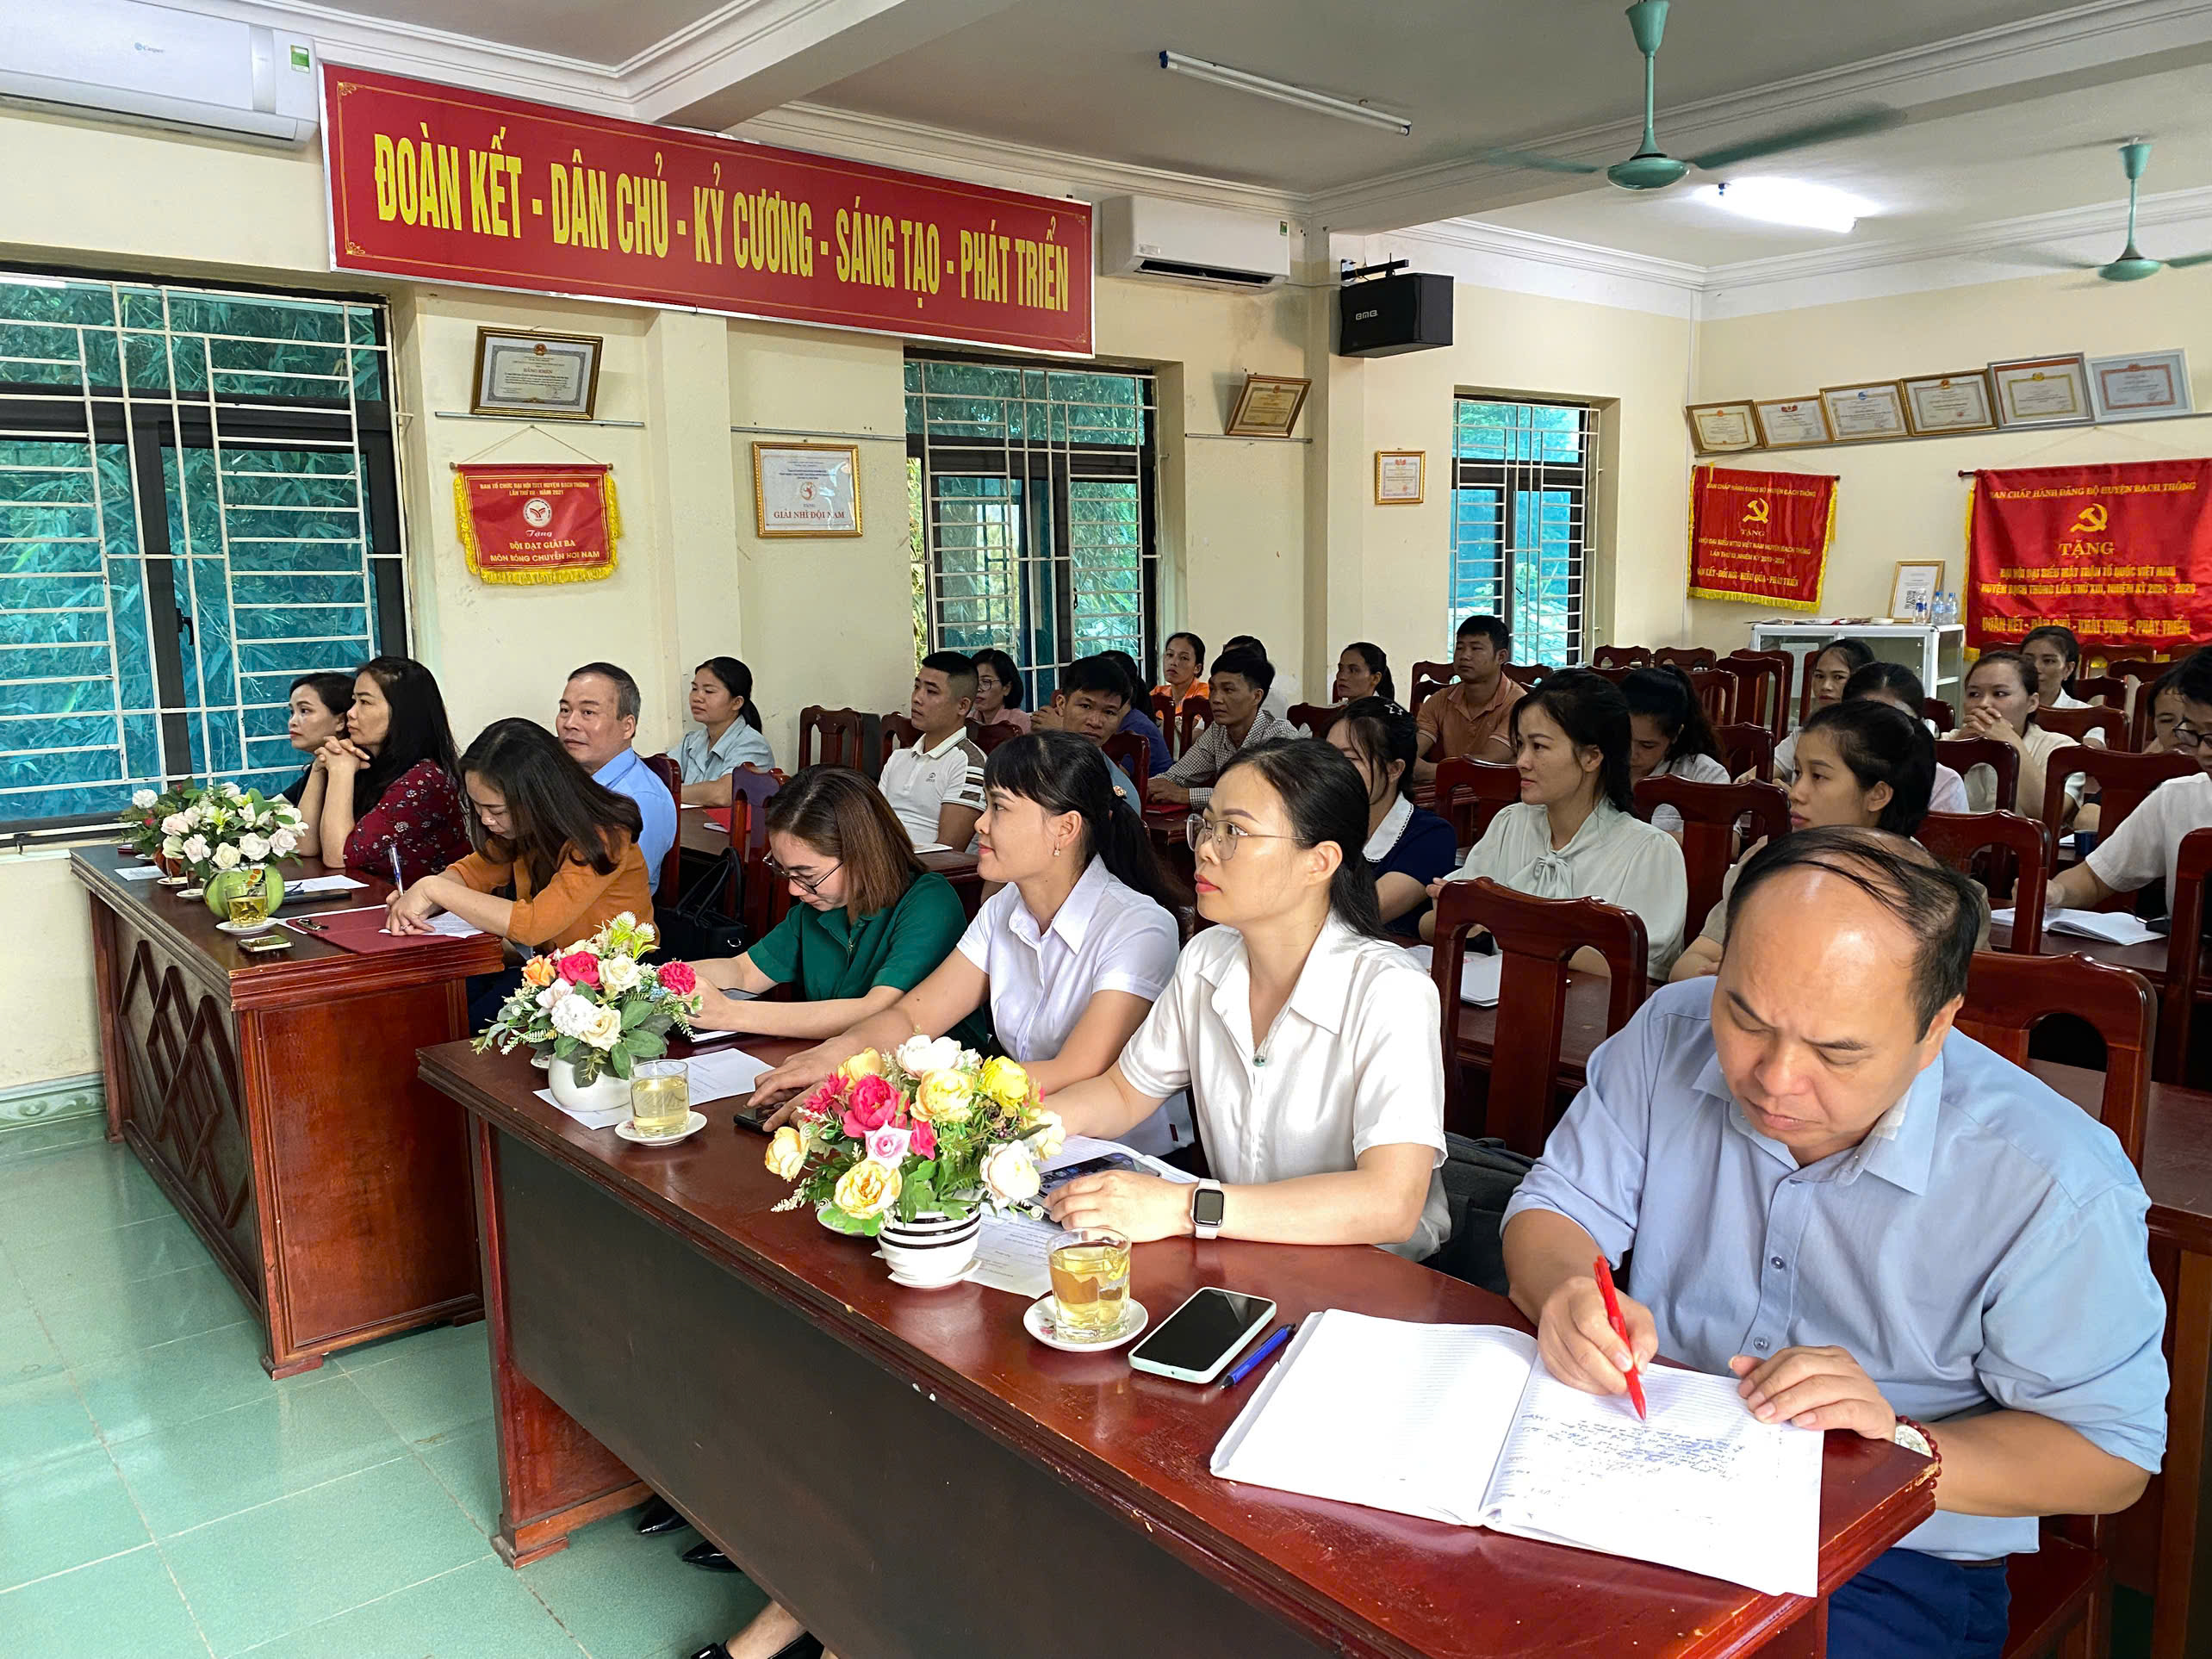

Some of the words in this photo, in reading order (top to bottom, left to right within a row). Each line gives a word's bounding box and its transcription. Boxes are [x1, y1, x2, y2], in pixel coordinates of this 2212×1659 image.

[374, 121, 463, 231] ĐOÀN
[469, 127, 522, 239] KẾT
[550, 148, 609, 251] DÂN
[615, 151, 669, 258] CHỦ
[693, 161, 724, 265] KỶ
[732, 188, 814, 277] CƯƠNG
[836, 196, 896, 289] SÁNG
[900, 219, 940, 308] TẠO
[960, 219, 1010, 304] PHÁT
[1015, 214, 1069, 312] TRIỂN
[2060, 539, 2116, 558] TẶNG
